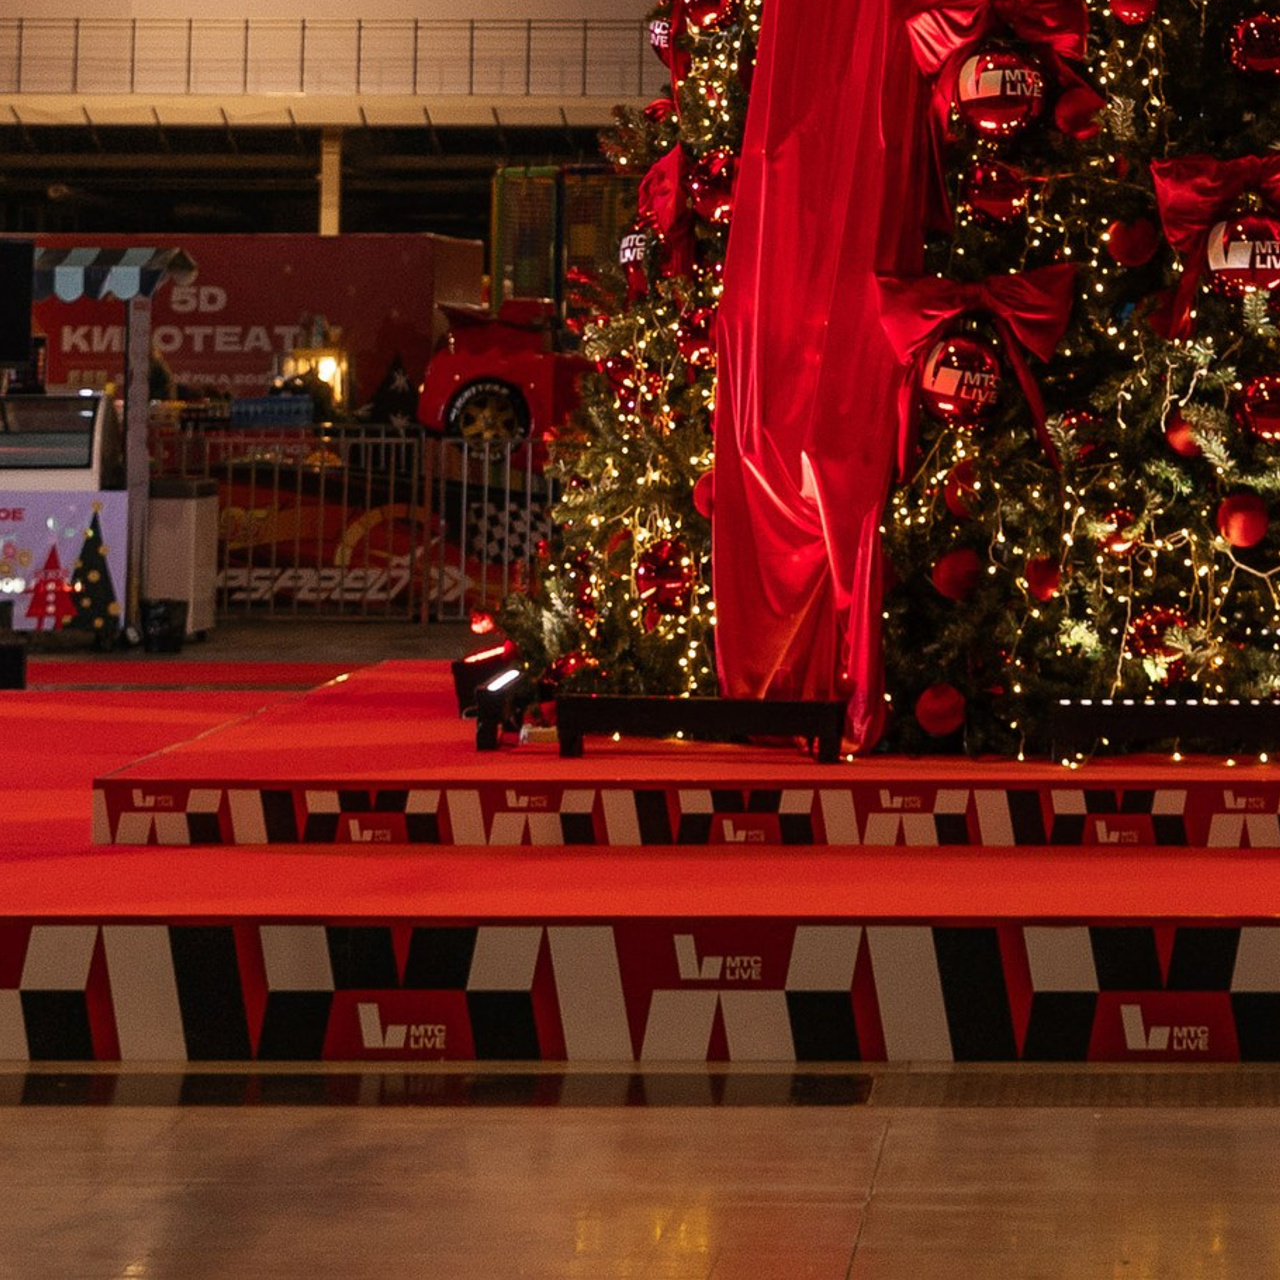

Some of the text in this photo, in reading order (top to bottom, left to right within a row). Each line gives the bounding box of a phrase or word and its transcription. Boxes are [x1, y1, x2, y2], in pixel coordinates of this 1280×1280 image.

[1006, 82, 1042, 97] LIVE
[171, 286, 227, 312] 5D
[61, 325, 301, 353] КИОТЕАТ
[960, 386, 998, 404] LIVE
[726, 967, 762, 979] LIVE
[410, 1036, 446, 1048] LIVE
[1173, 1037, 1209, 1049] LIVE
